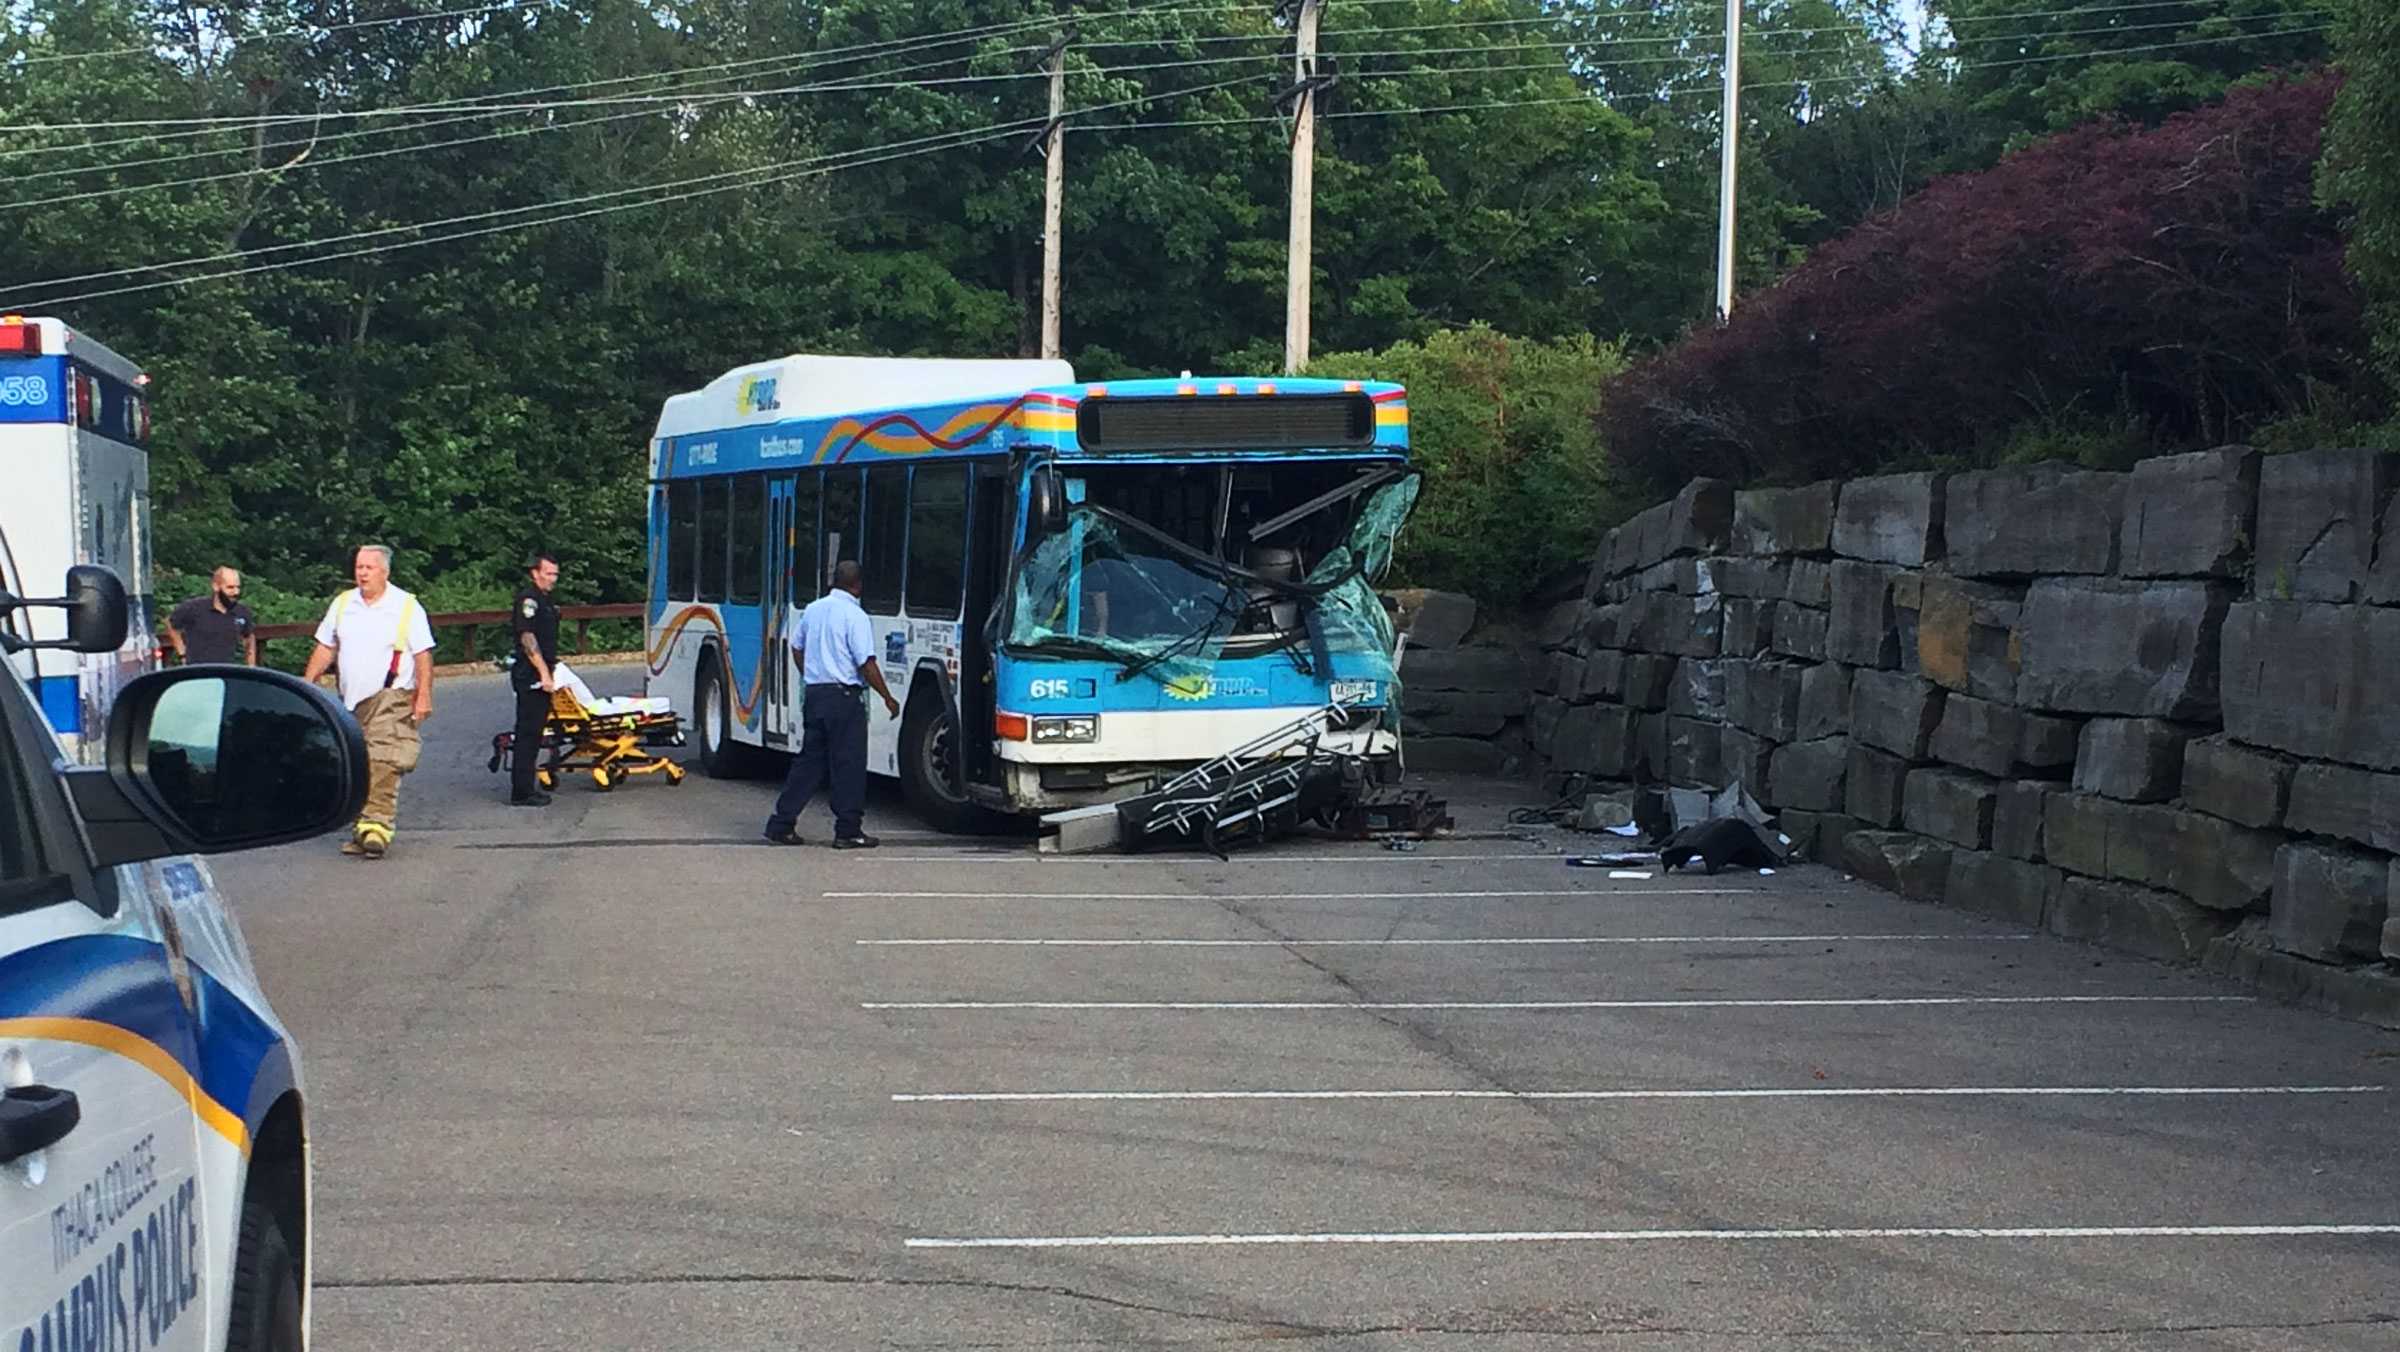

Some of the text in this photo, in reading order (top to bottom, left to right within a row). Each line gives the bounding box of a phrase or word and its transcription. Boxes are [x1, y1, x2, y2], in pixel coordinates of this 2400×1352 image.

[0, 375, 48, 406] 58
[1030, 679, 1070, 699] 615
[51, 1133, 158, 1274] ITHACA COLLEGE
[18, 1176, 198, 1352] PUS POLICE
